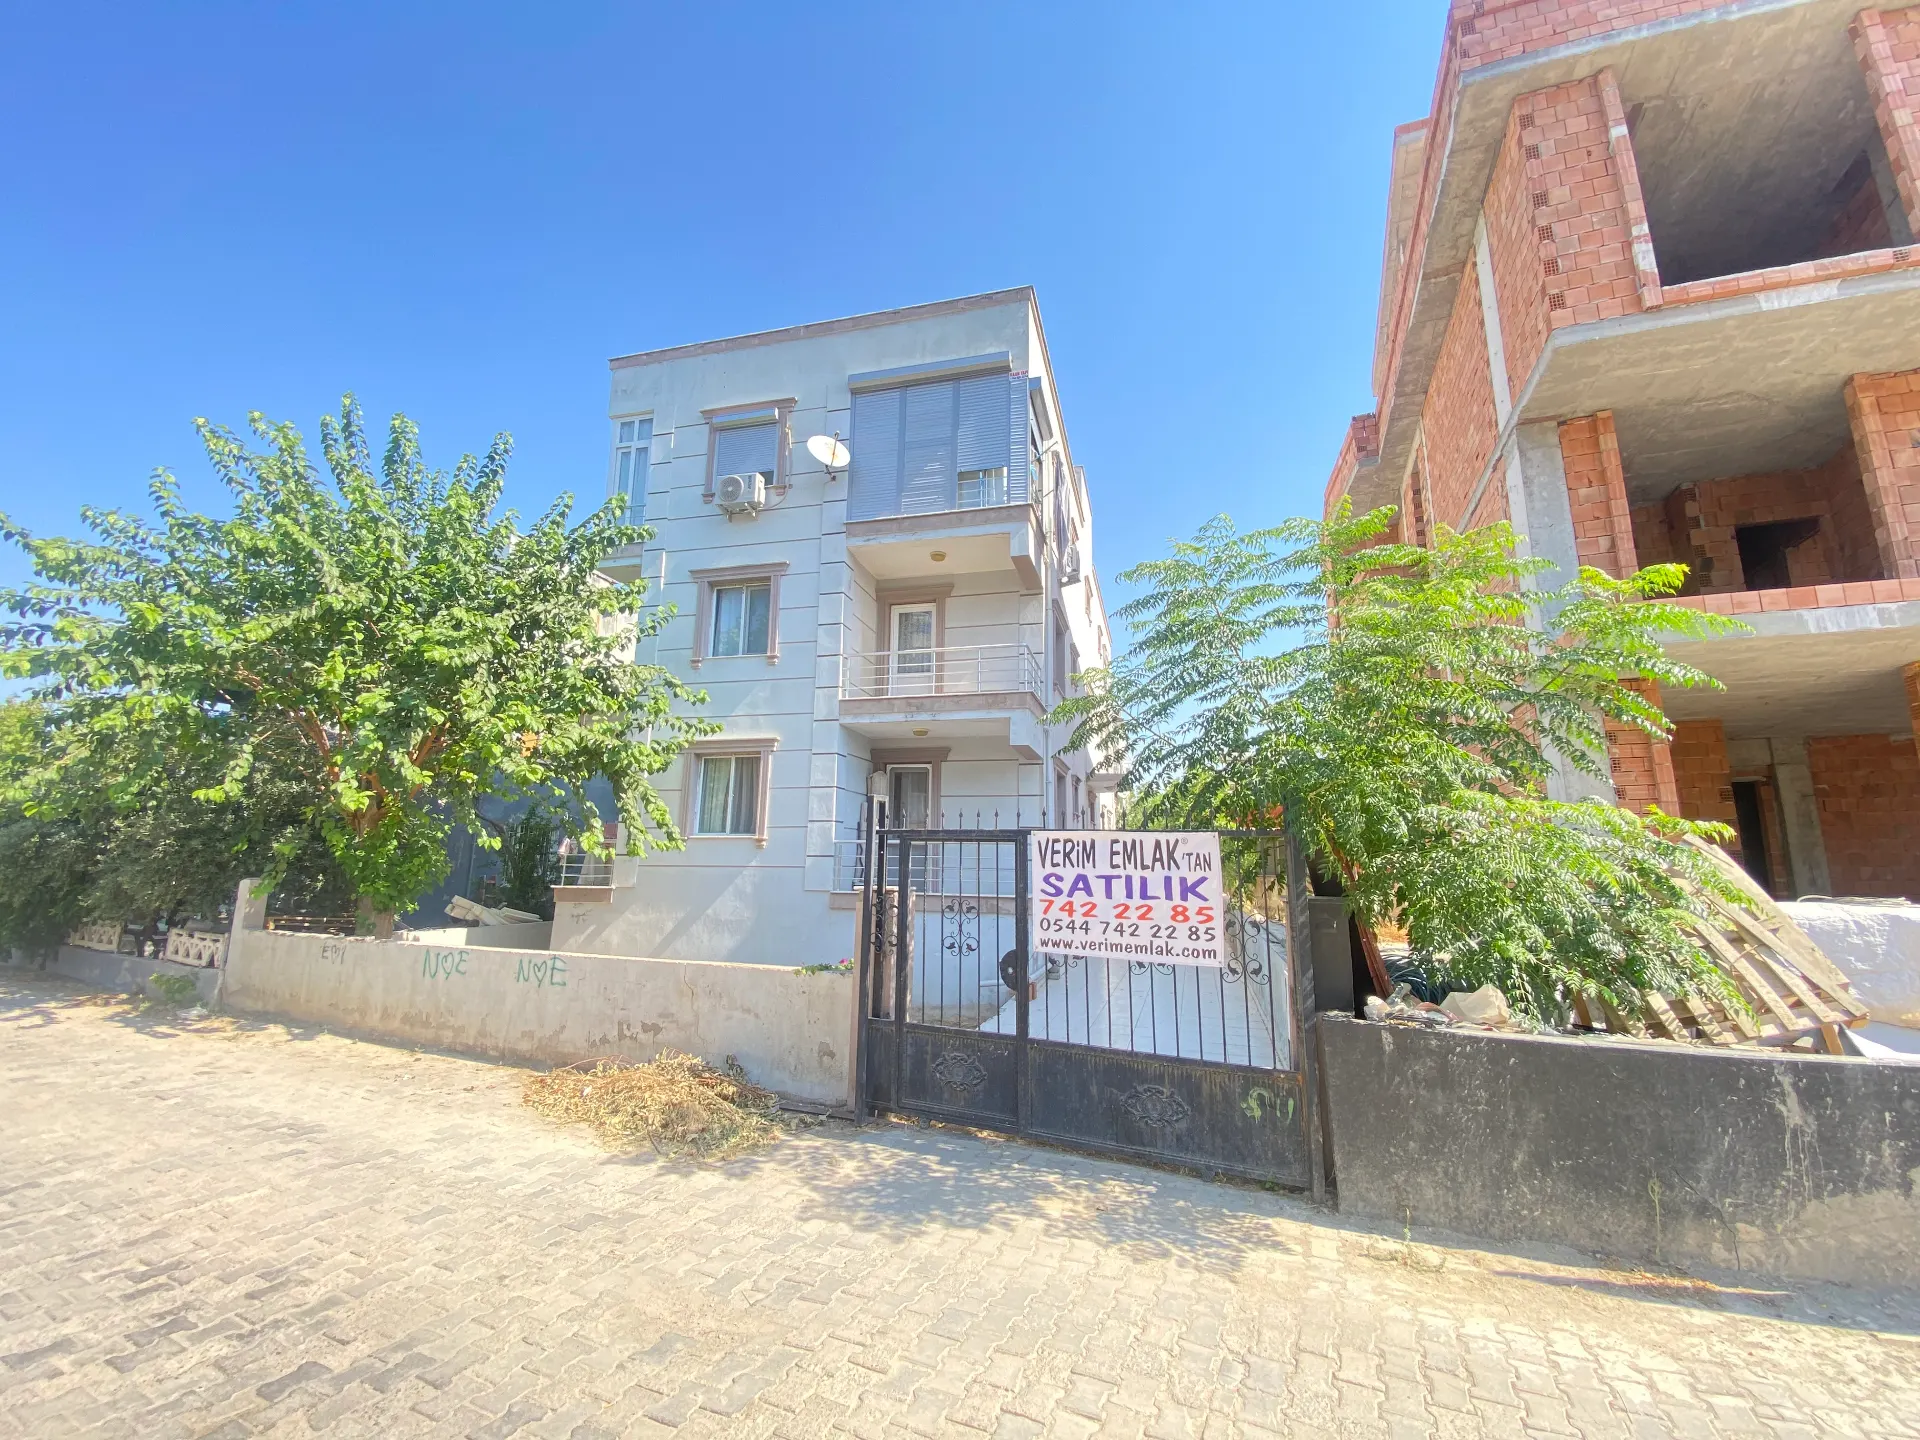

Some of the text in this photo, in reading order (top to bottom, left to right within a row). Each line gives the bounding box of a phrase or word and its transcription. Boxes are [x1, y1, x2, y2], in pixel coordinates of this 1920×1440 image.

[1040, 872, 1209, 902] SATILIK
[1039, 899, 1214, 924] 742 22 85
[1040, 918, 1216, 942] 0544 742 22 85
[1040, 938, 1217, 959] www.verimemlak.com
